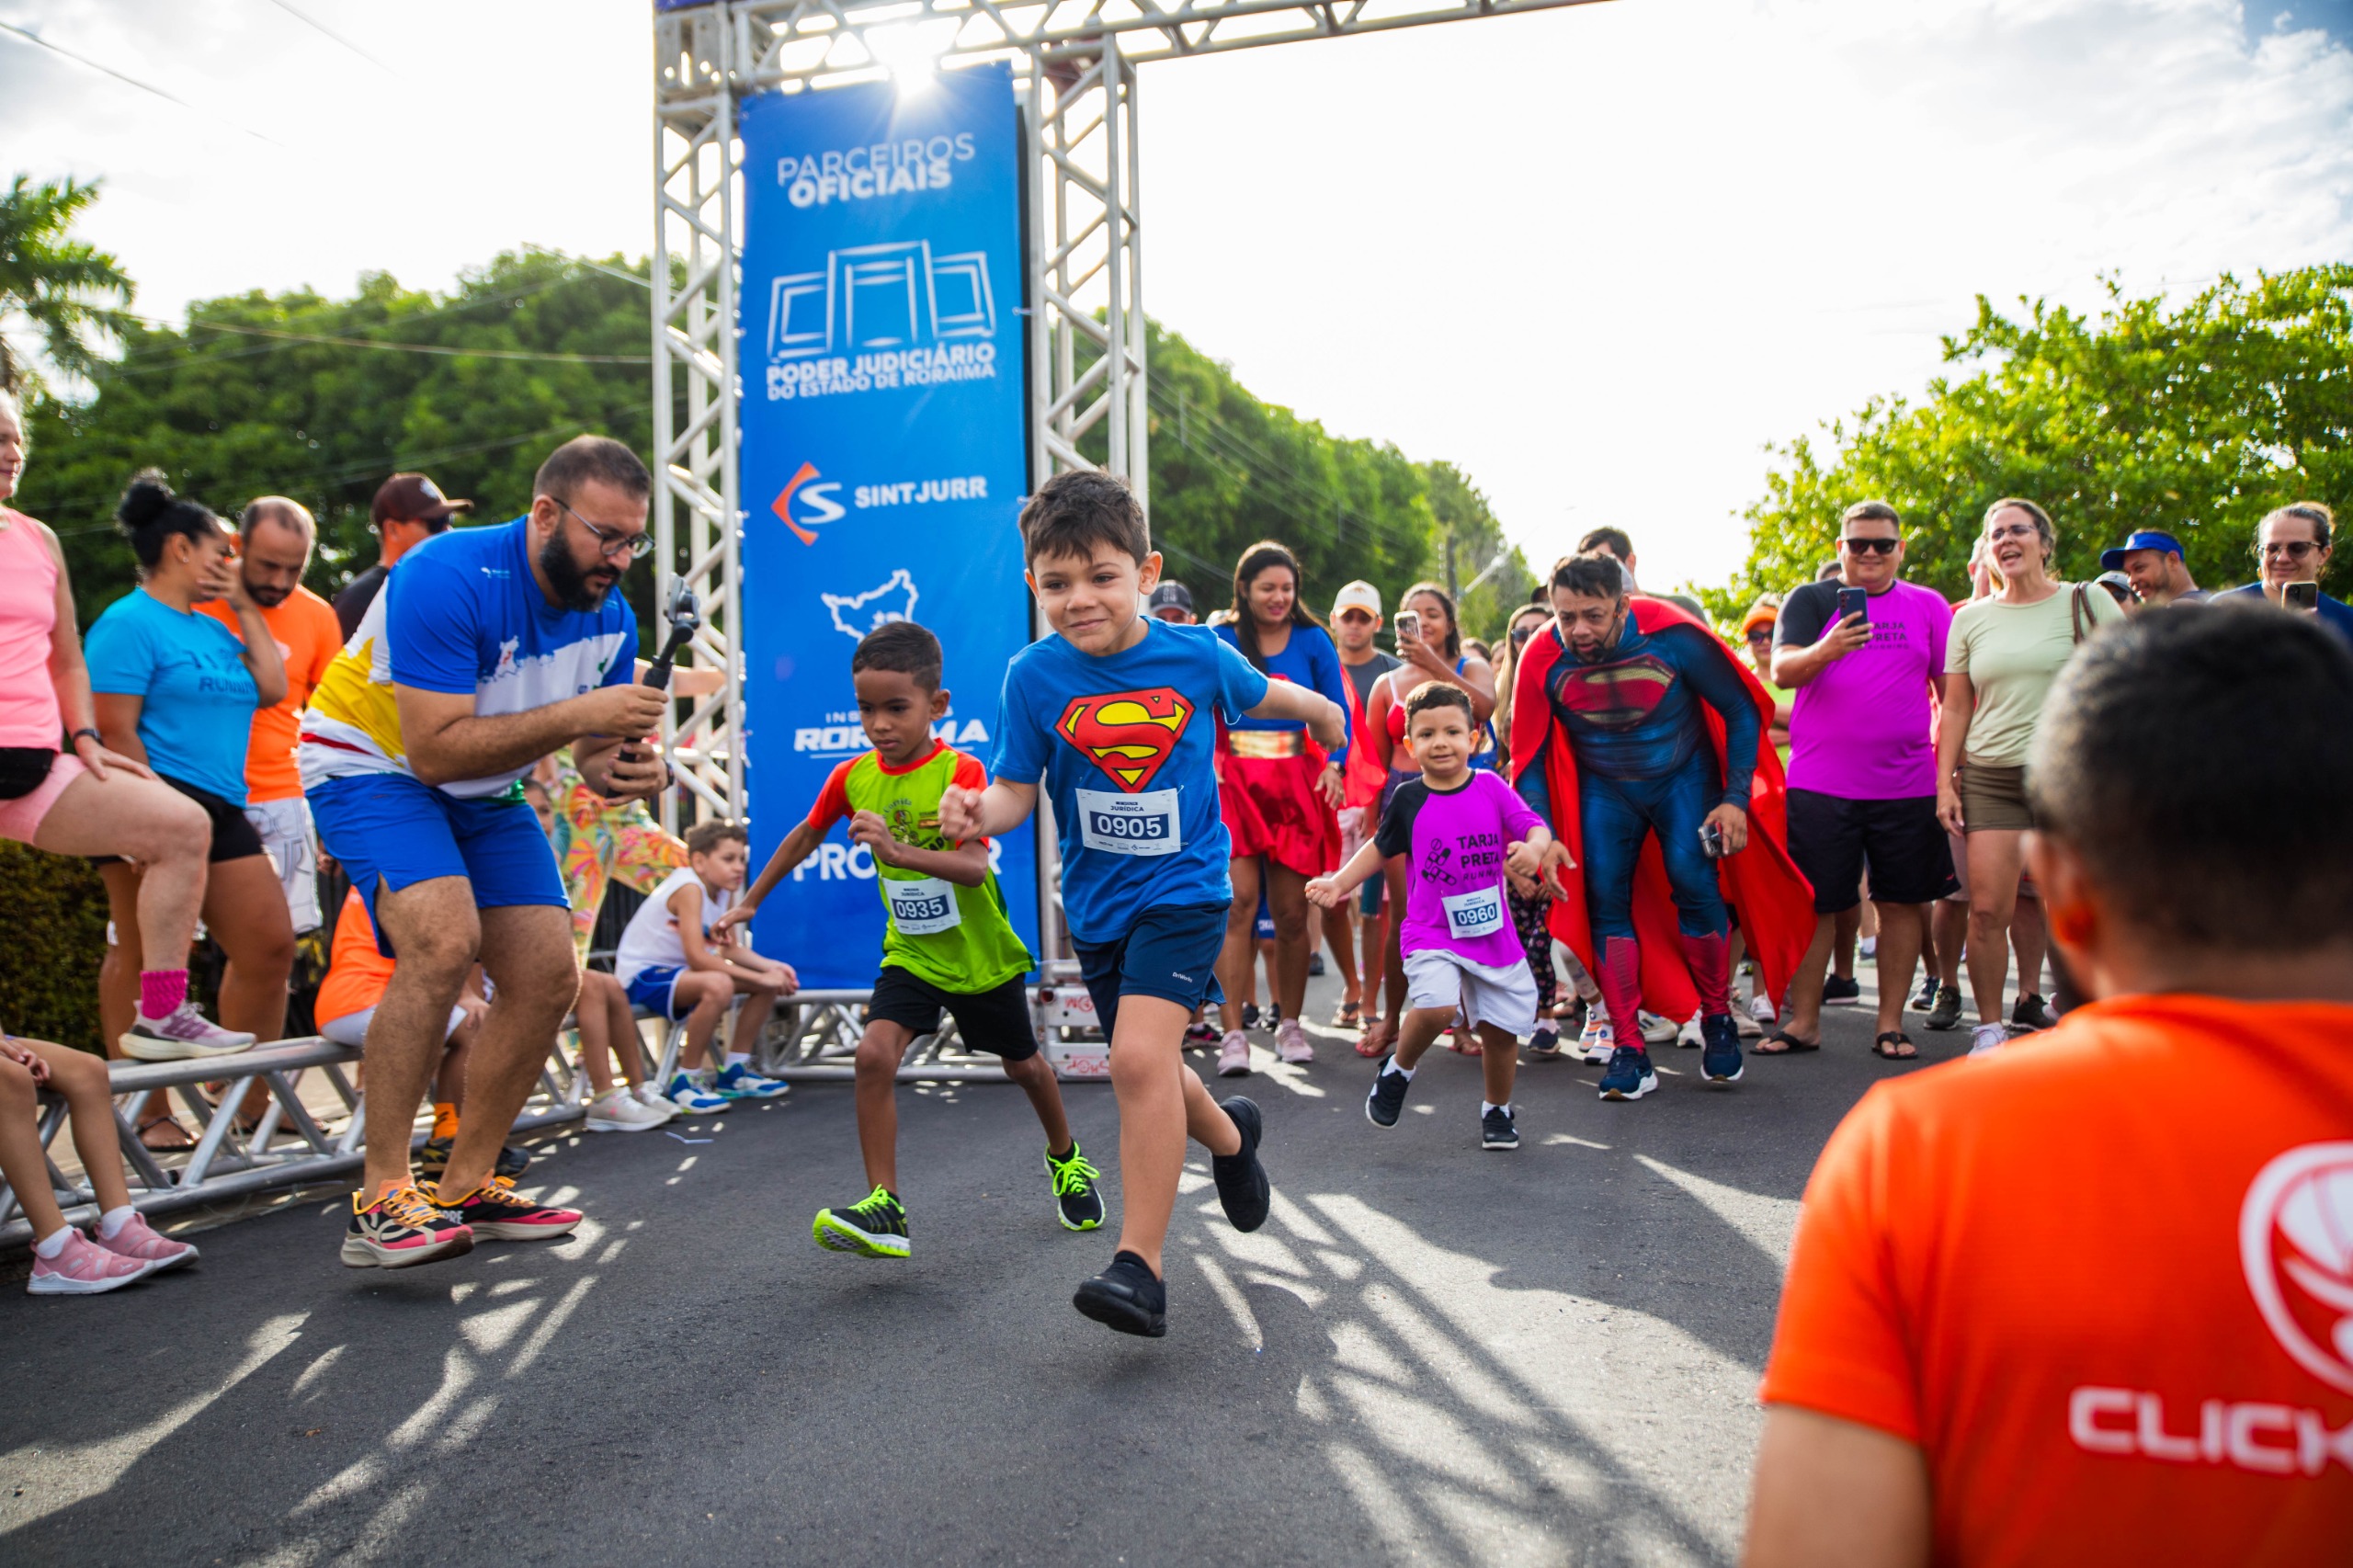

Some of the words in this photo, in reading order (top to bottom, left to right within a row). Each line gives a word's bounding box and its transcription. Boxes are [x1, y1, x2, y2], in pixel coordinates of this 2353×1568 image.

[778, 133, 975, 186] PARCEIROS
[788, 162, 952, 208] OFICIAIS
[767, 357, 849, 387] PODER
[851, 341, 996, 378] JUDICIÁRIO
[767, 384, 796, 402] DO
[799, 375, 871, 398] ESTADO
[874, 372, 900, 390] DE
[904, 362, 996, 386] RORAIMA
[854, 475, 988, 508] SINTJURR
[793, 718, 990, 752] RORMA
[1097, 814, 1162, 837] 0905
[1456, 833, 1499, 850] TARJA
[1461, 851, 1500, 869] PRETA
[895, 898, 943, 918] 0935
[1458, 904, 1495, 925] 0960
